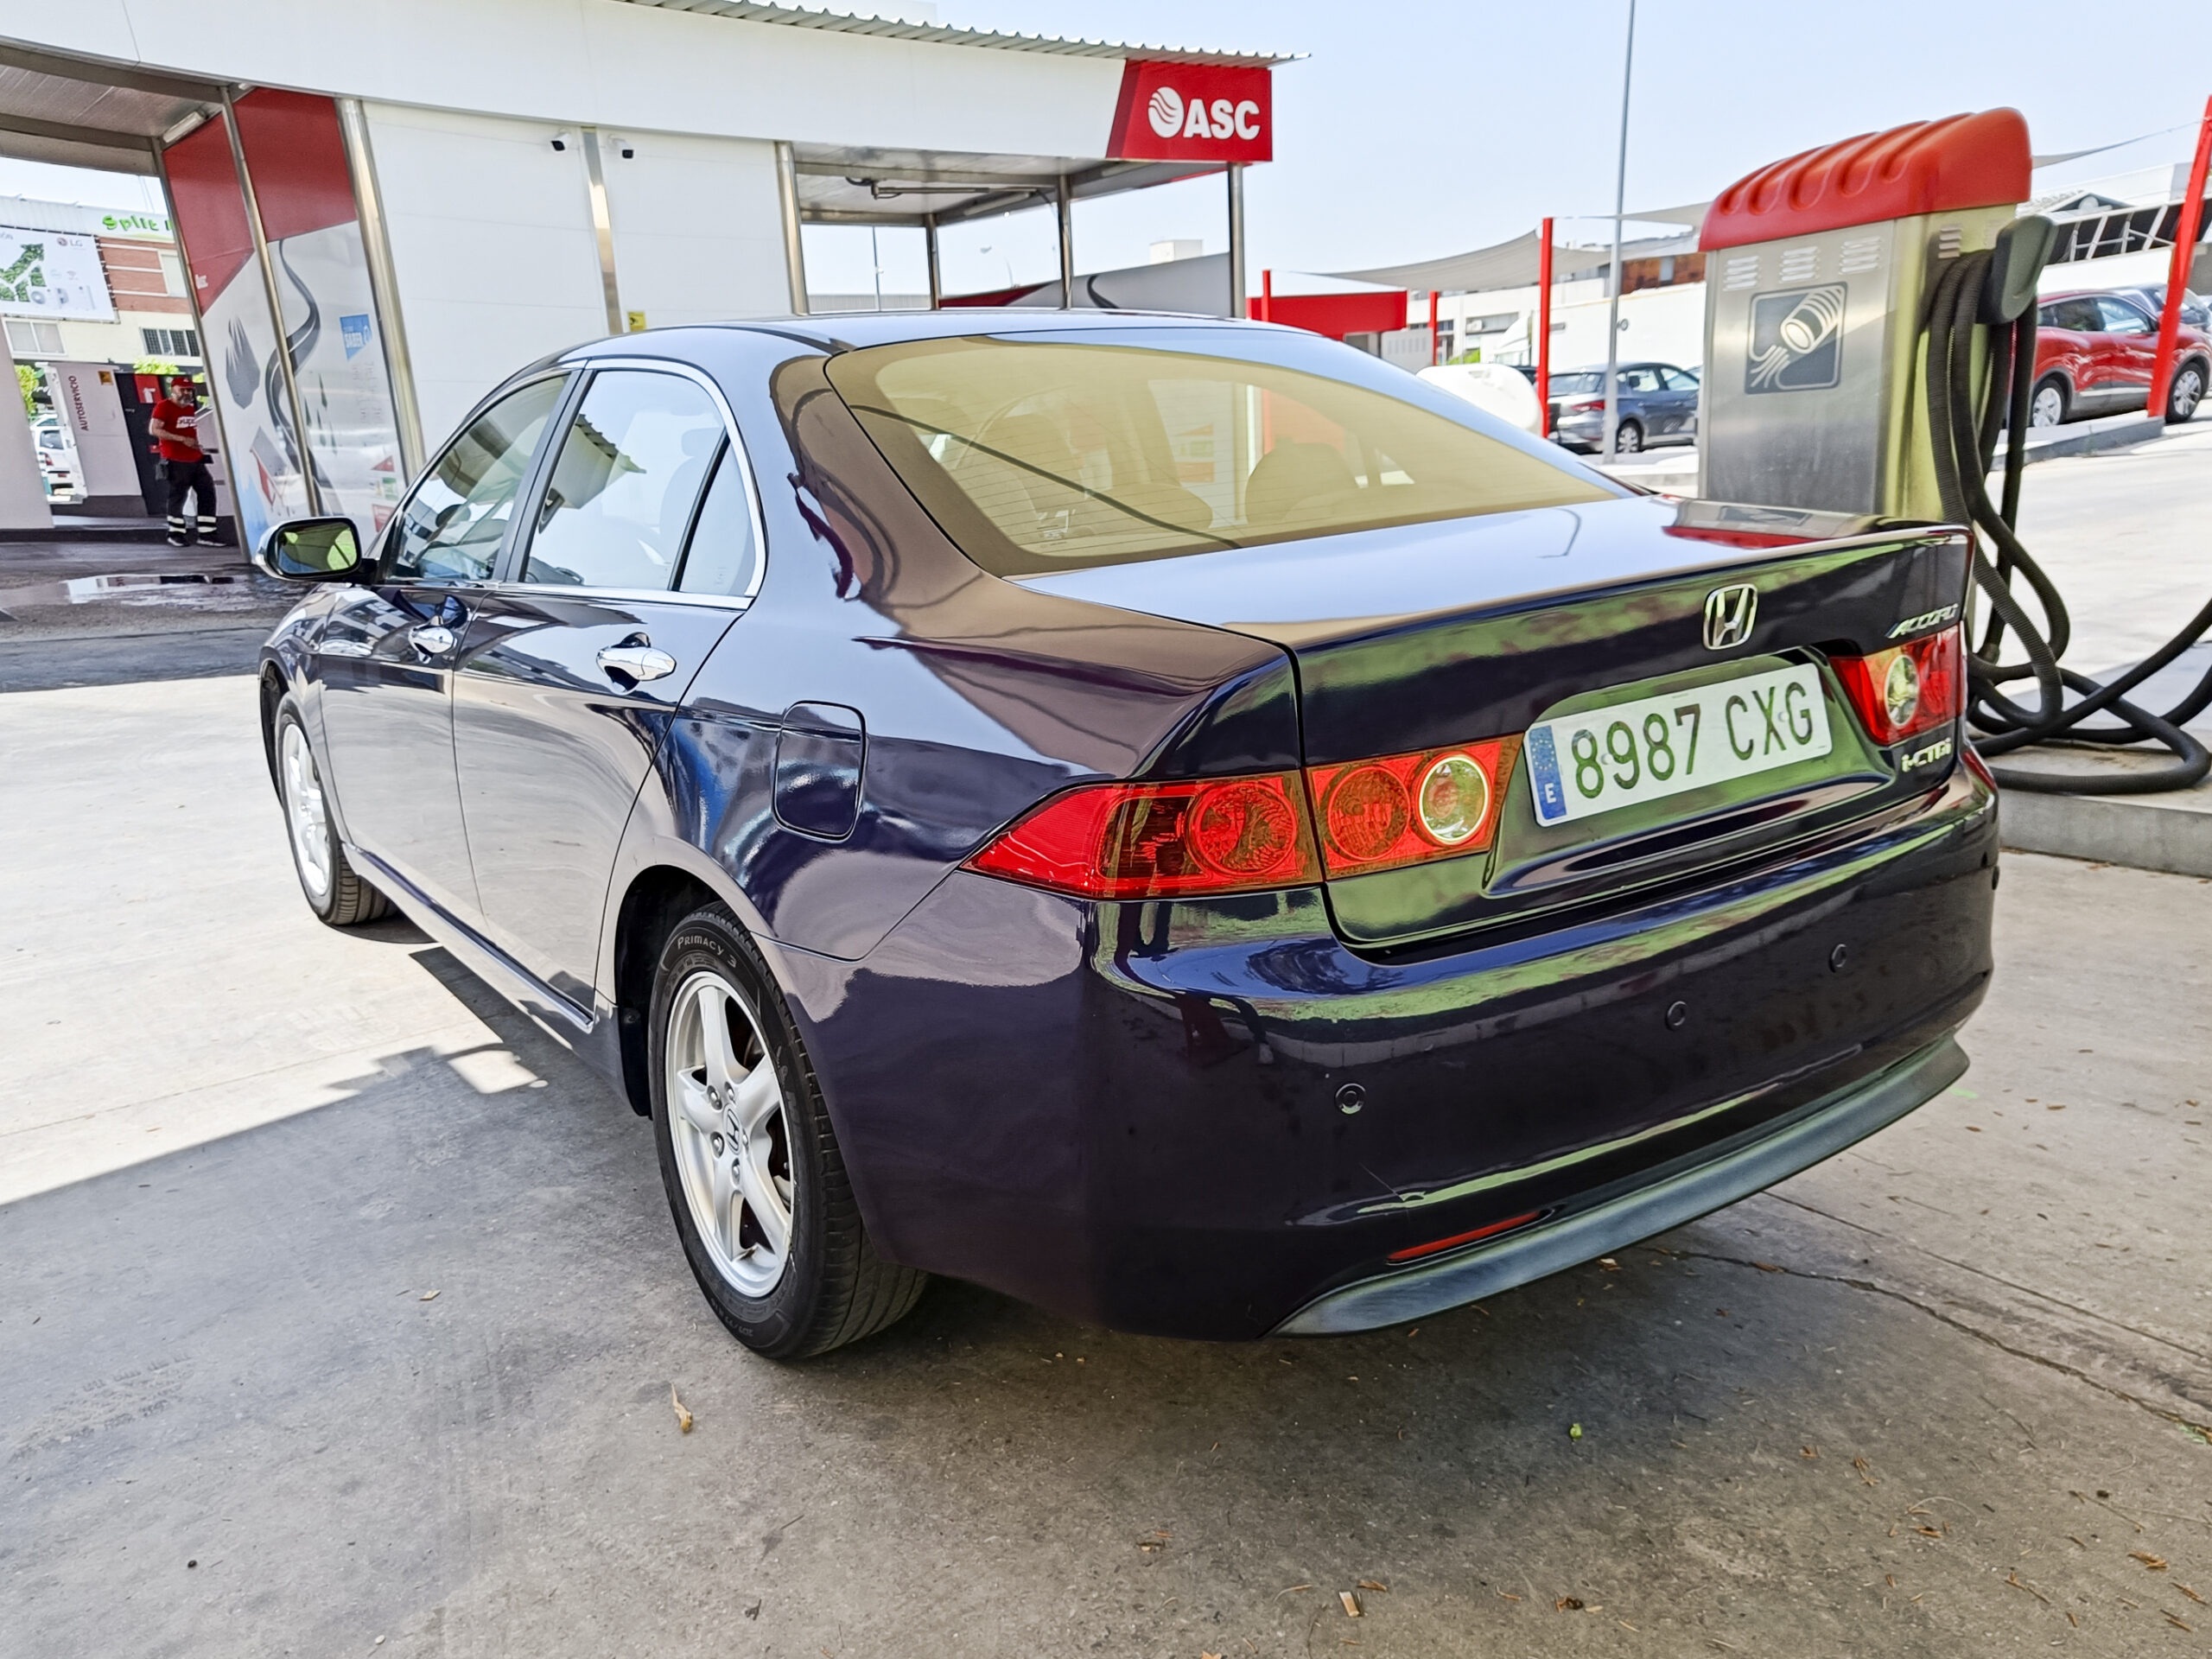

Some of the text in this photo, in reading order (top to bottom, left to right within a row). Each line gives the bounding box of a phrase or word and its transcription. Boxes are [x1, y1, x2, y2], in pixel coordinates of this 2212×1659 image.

[1183, 99, 1260, 140] ASC
[69, 238, 83, 247] LG
[68, 375, 89, 432] AUTOSERVICIO
[1571, 681, 1814, 798] 8987 CXG
[1544, 782, 1558, 804] E
[677, 935, 738, 968] PRIMACY 3
